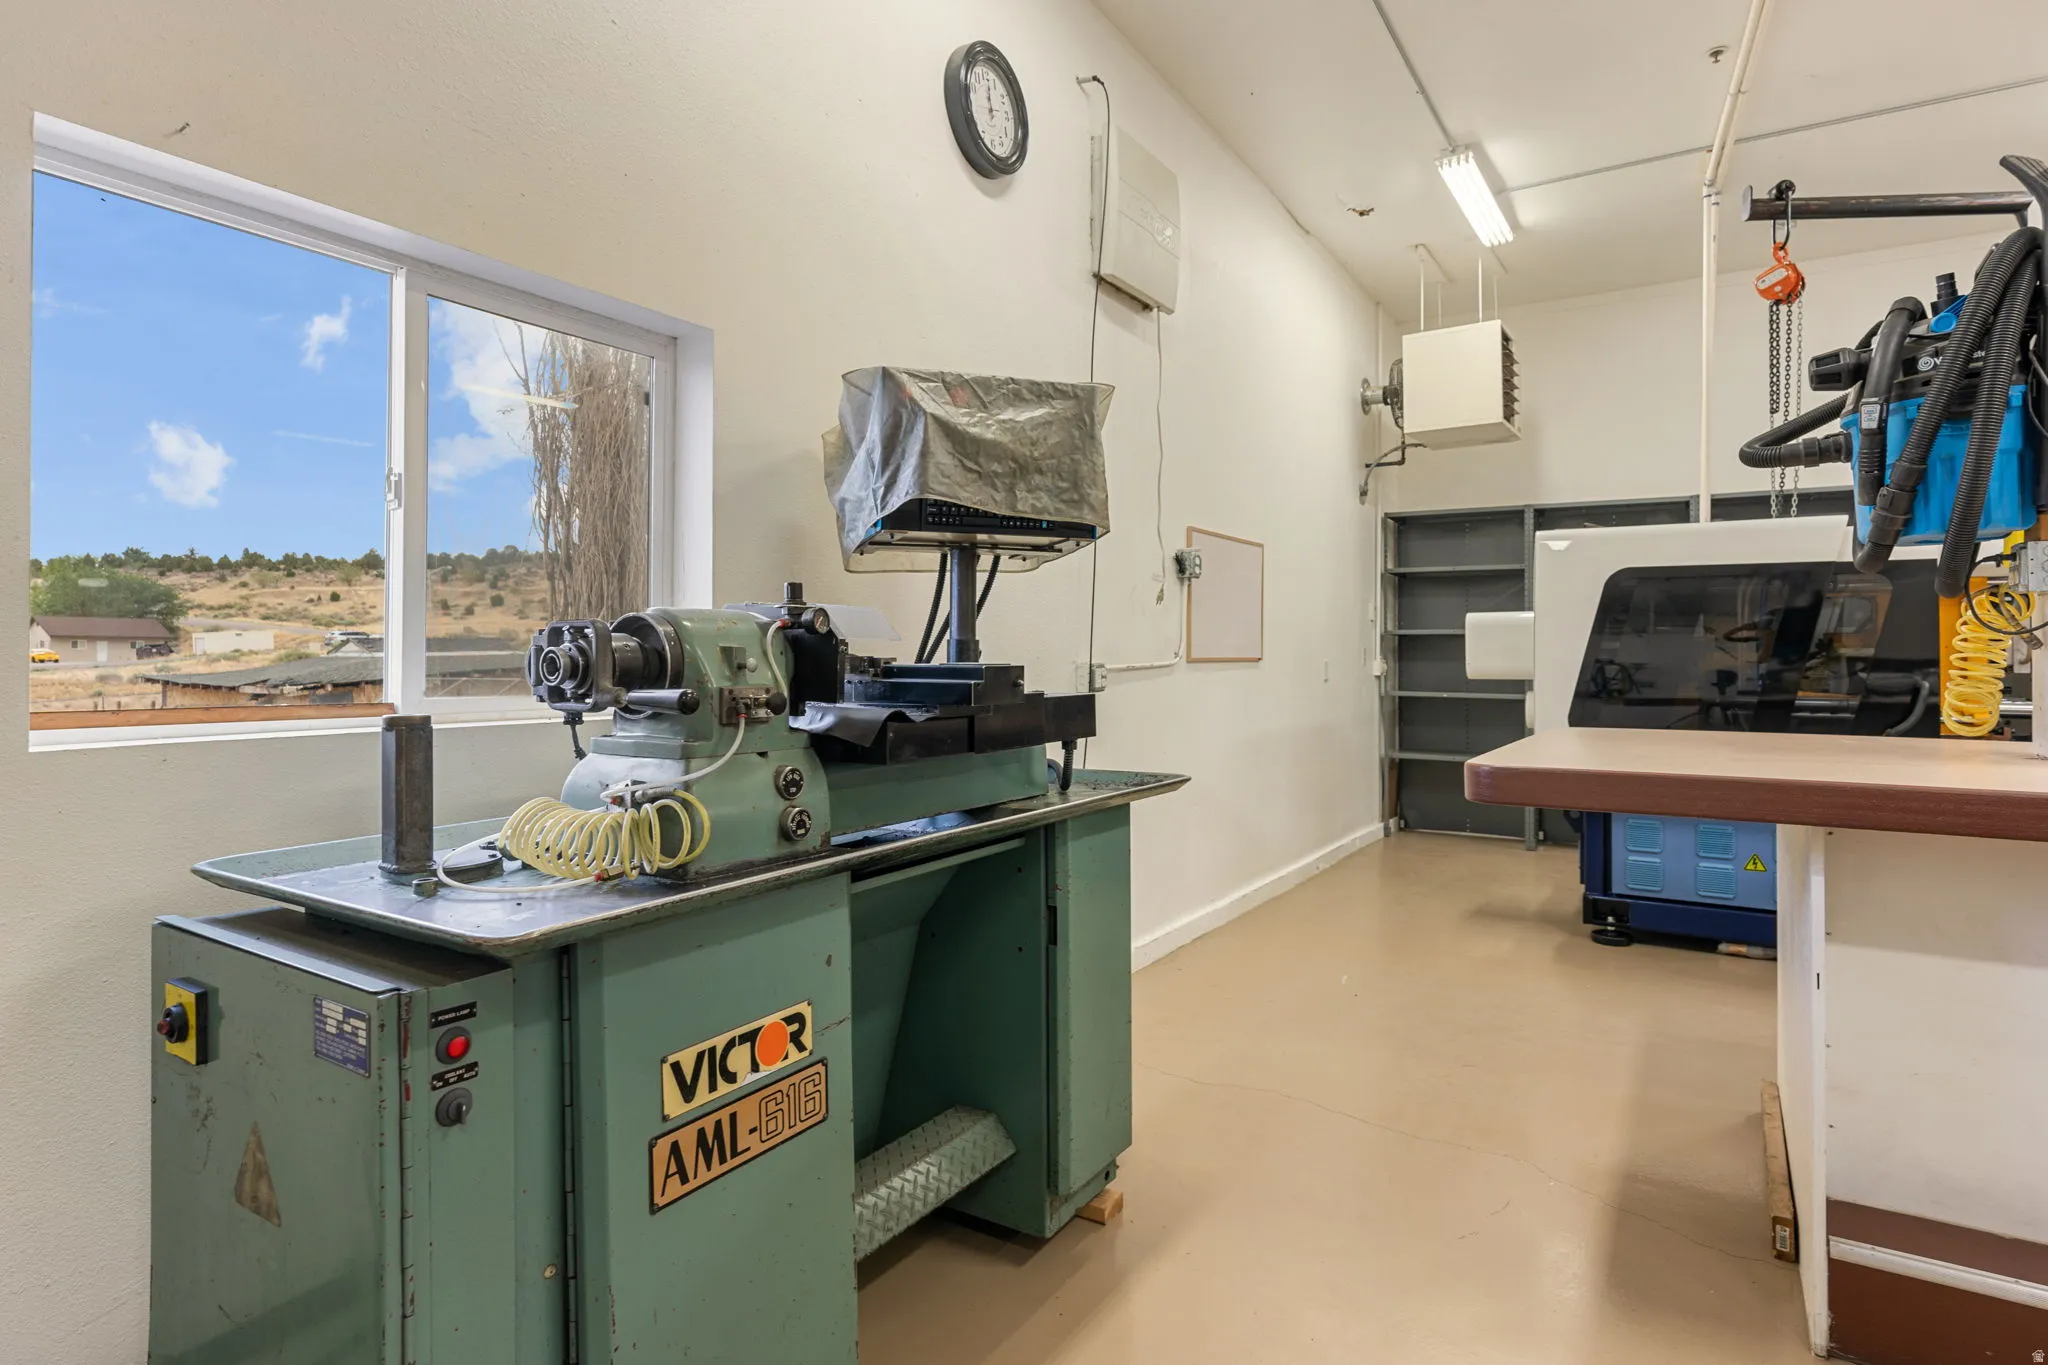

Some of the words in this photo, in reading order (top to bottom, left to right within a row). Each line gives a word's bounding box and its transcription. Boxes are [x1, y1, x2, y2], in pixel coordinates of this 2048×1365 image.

[456, 1008, 471, 1016] LAMP
[669, 1011, 808, 1105] VICTOR
[660, 1071, 822, 1198] AML-616
